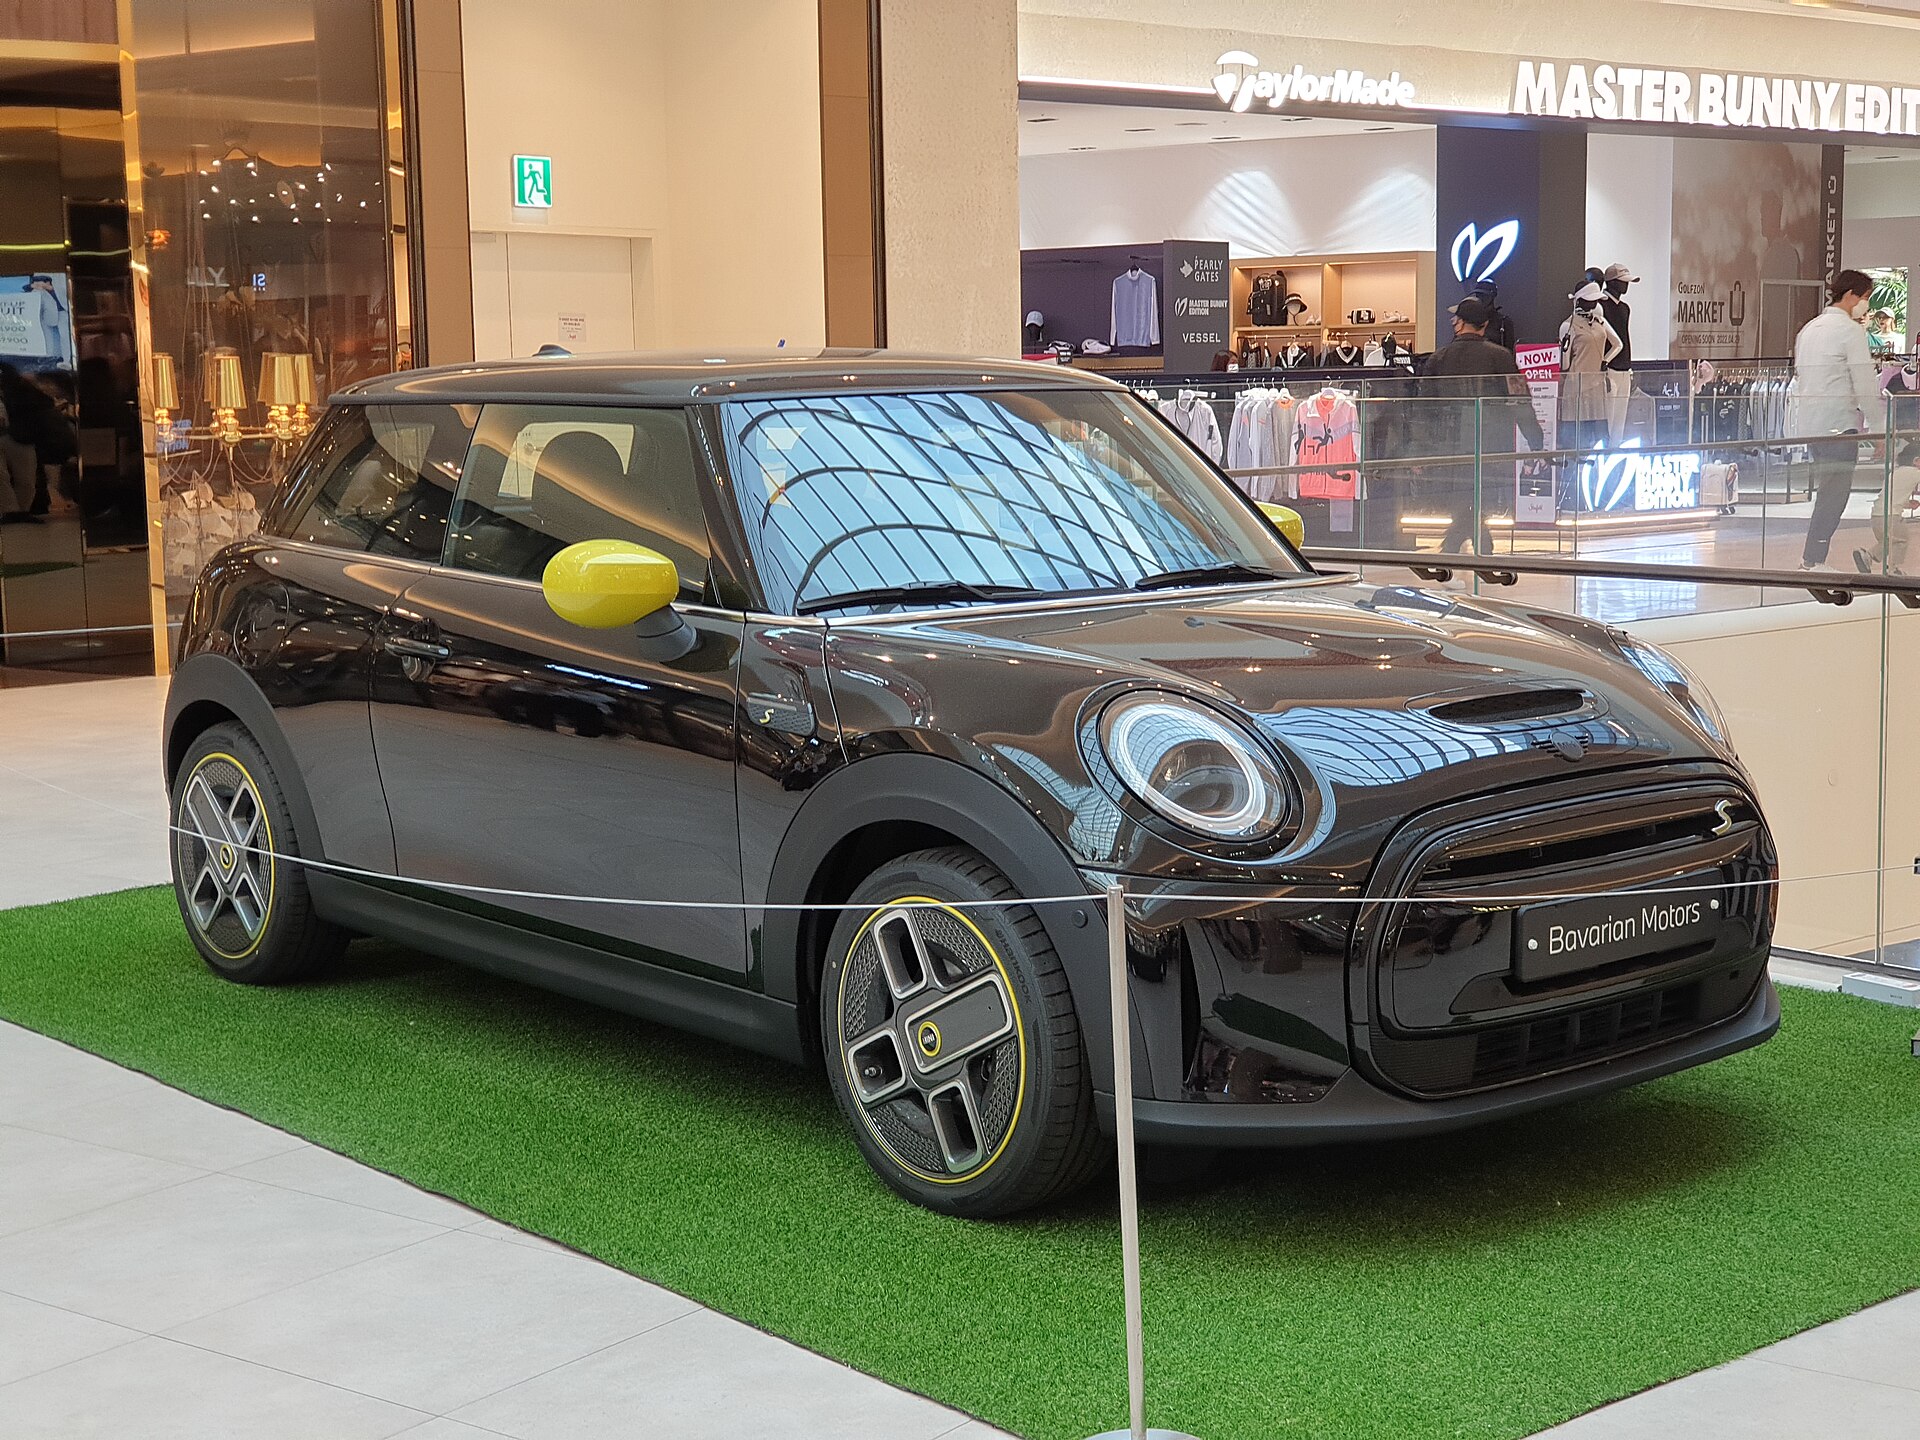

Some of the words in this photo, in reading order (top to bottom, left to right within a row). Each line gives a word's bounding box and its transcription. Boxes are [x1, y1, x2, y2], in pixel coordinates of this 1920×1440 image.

[1211, 50, 1415, 113] TaylorMade
[1514, 60, 1692, 124] MASTER
[1698, 73, 1840, 130] BUNNY
[1845, 83, 1920, 136] EDIT
[1194, 259, 1223, 271] PEARLY
[1194, 271, 1219, 282] GATES
[1188, 299, 1209, 308] MASTER
[1210, 299, 1228, 308] BUNNY
[1188, 308, 1209, 316] EDITION
[1677, 300, 1725, 323] MARKET
[1182, 332, 1221, 343] VESSEL
[1523, 351, 1553, 366] NOW
[1525, 368, 1552, 380] OPEN
[1638, 454, 1701, 475] MASTER
[1637, 471, 1692, 492] BUNNY
[1636, 488, 1695, 511] EDITION
[1549, 914, 1636, 955] Bavarian
[1641, 902, 1701, 935] Motors
